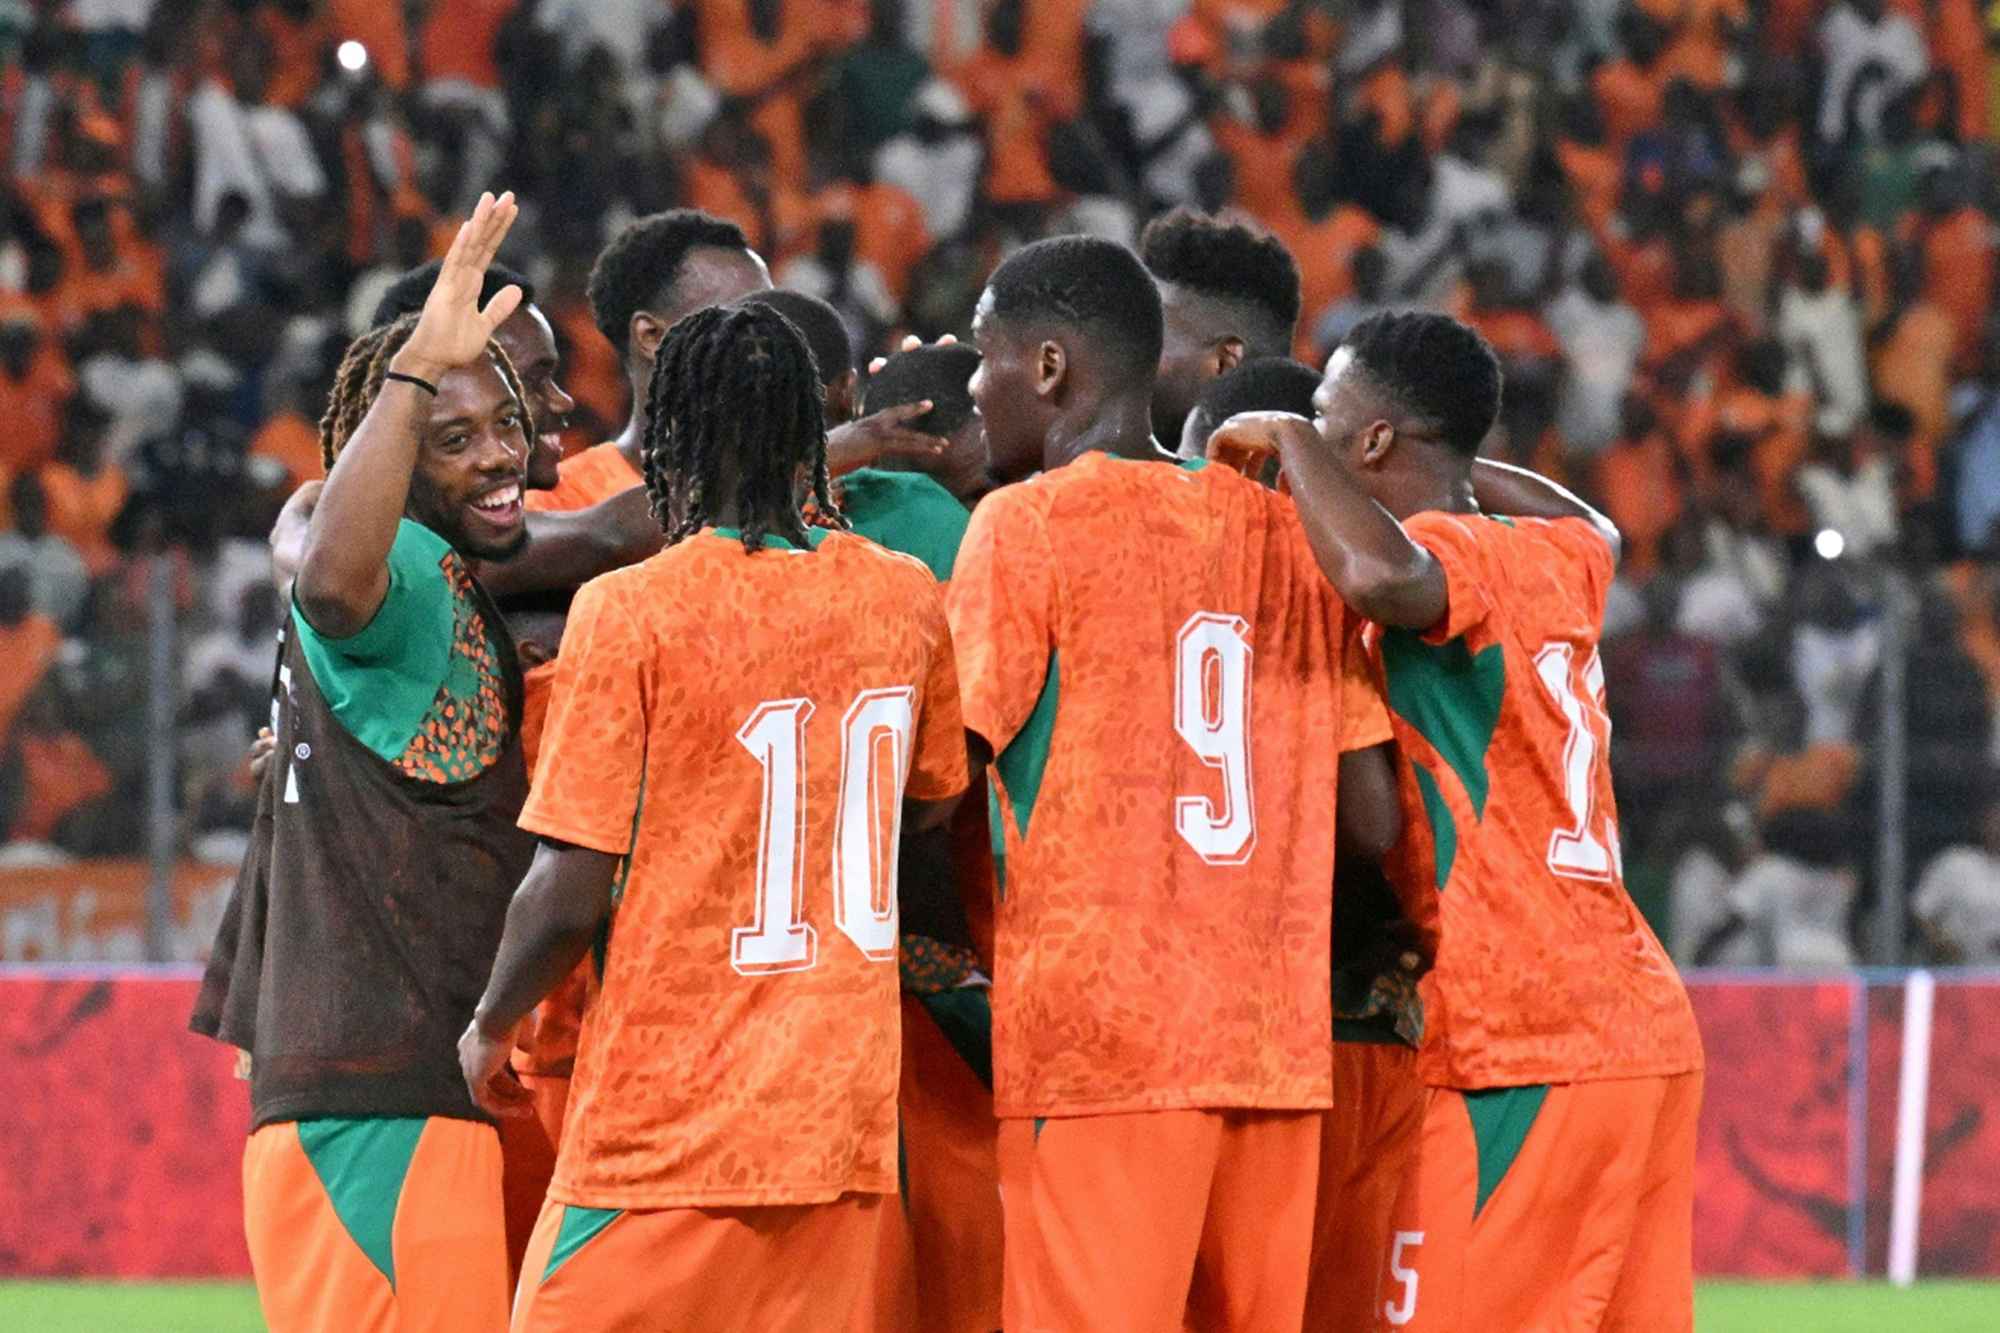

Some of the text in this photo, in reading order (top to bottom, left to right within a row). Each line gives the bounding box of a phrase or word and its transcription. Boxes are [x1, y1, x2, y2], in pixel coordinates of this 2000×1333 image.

[731, 686, 916, 976] 10
[1174, 611, 1257, 865] 9
[1533, 642, 1623, 882] 1
